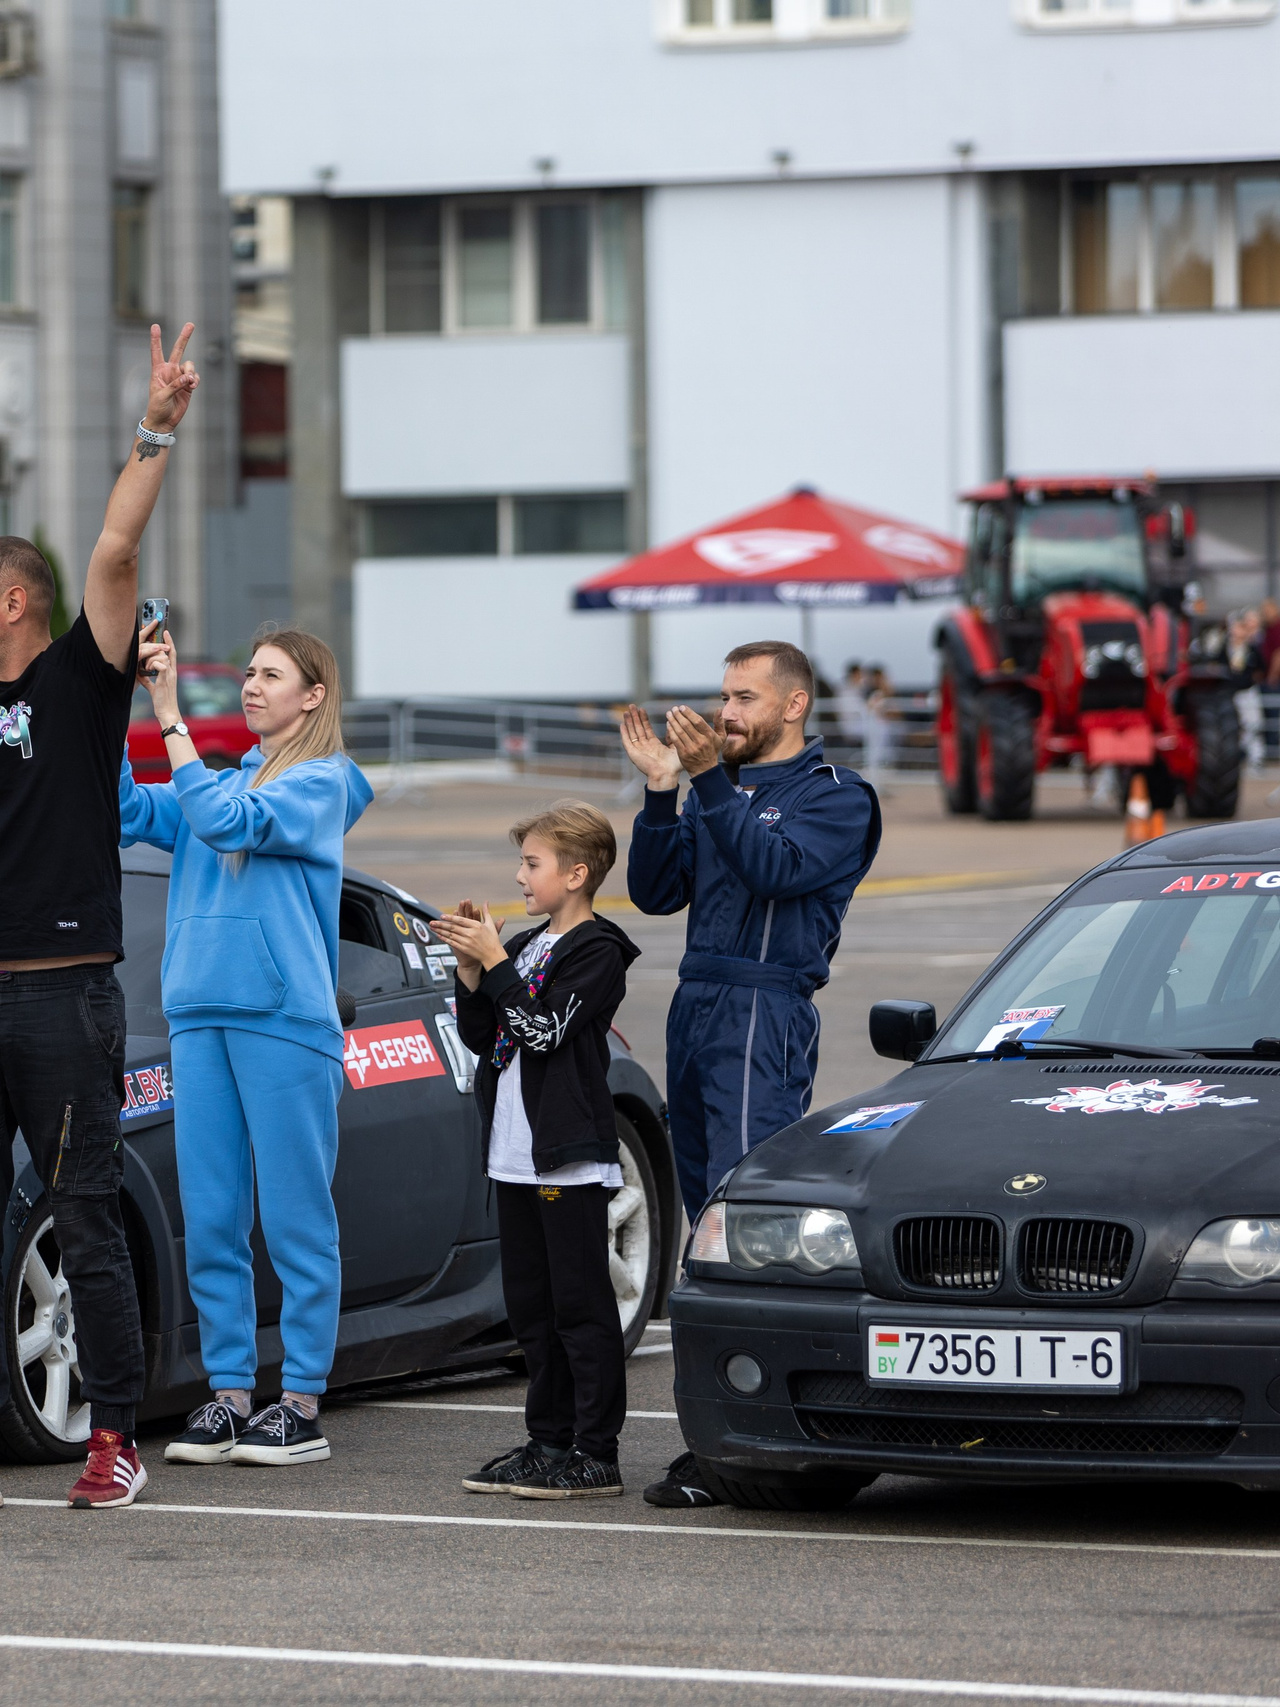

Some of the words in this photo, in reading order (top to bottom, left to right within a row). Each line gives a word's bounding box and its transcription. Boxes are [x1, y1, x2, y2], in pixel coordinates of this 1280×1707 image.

[759, 812, 782, 820] RLG
[369, 1034, 435, 1070] CEPSA
[121, 1066, 169, 1112] T.BY
[877, 1356, 898, 1374] BY
[905, 1332, 996, 1376] 7356
